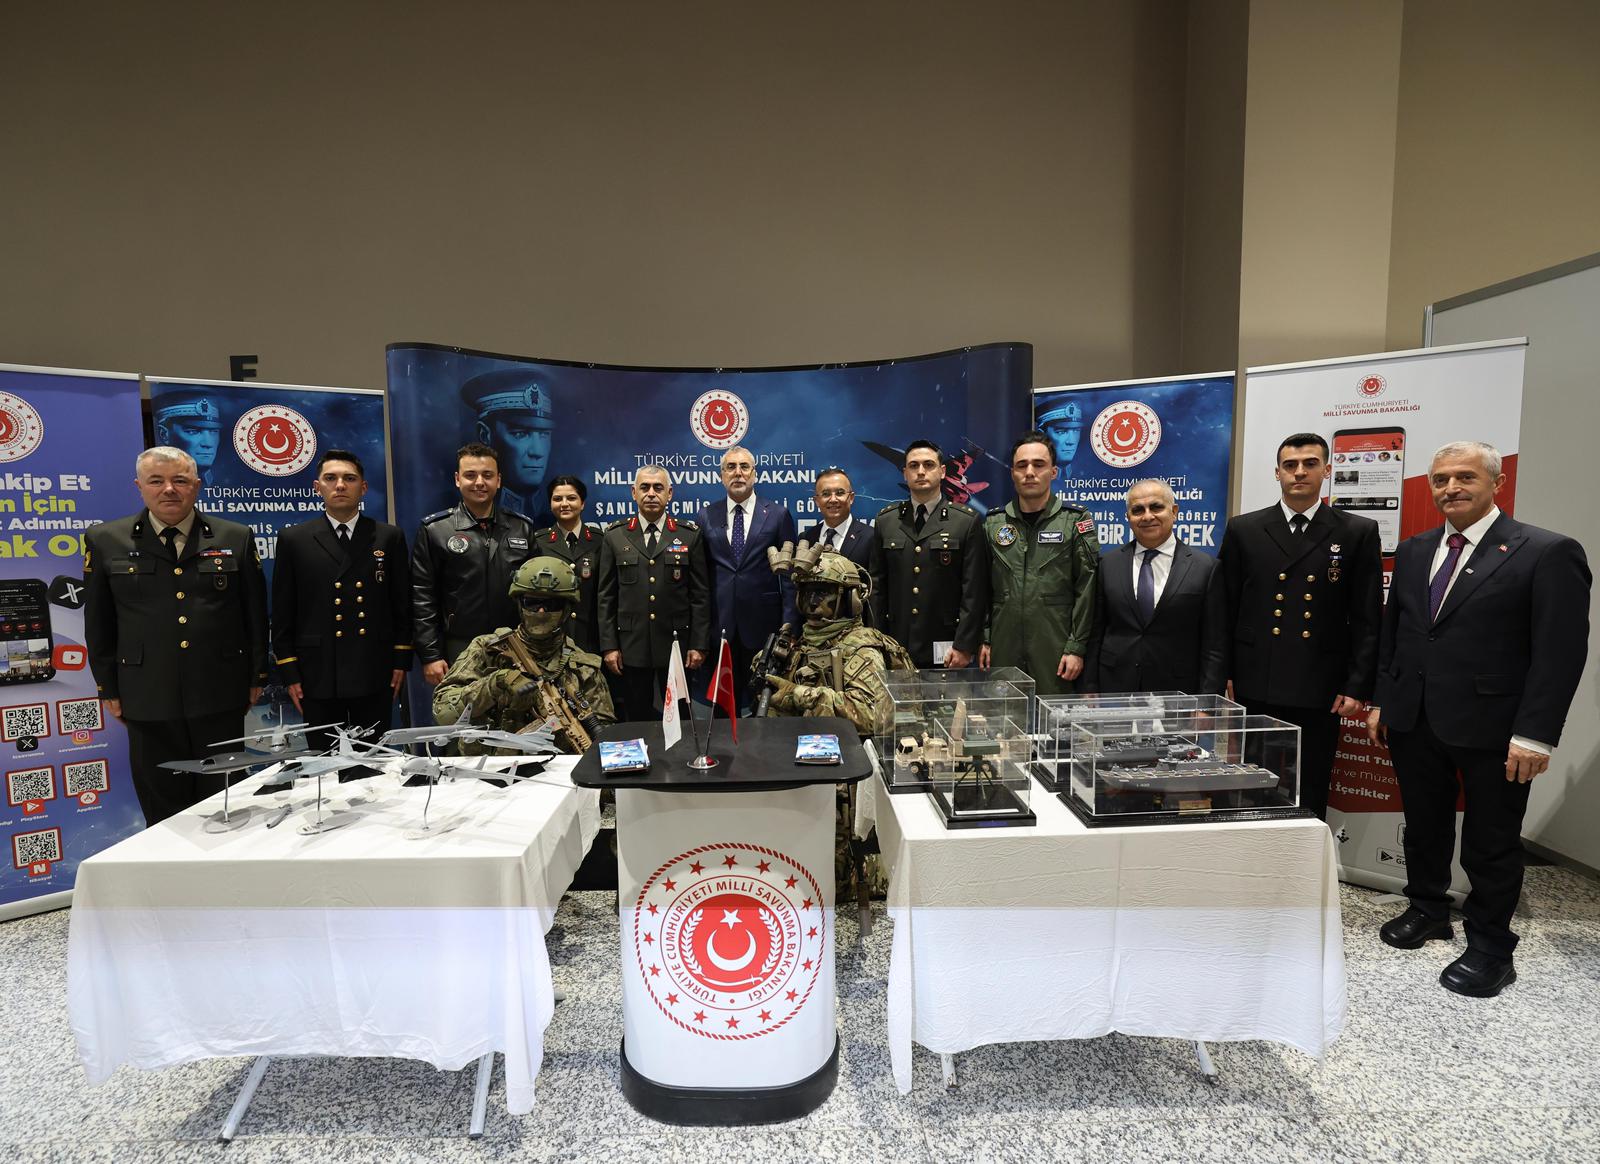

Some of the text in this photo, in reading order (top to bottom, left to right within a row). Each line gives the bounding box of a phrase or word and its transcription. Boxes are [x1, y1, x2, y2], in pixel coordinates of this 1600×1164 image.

[1335, 399, 1409, 410] TÜRKİYE CUMHURİYETİ
[1343, 408, 1378, 416] SAVUNMA
[1380, 404, 1421, 413] BAKANLIĞI
[634, 453, 697, 467] TÜRKİYE
[59, 474, 91, 491] Et
[594, 467, 636, 484] MİLL
[1065, 477, 1107, 488] TÜRKİYE
[204, 486, 323, 498] TÜRKİYE CUMHUR
[1055, 488, 1203, 501] İLLÎ SAVUNM NLIĞI
[24, 492, 76, 515] İçin
[194, 500, 223, 513] İLLÎ
[227, 501, 295, 512] SAVUNMA
[596, 502, 636, 517] ŞANL
[1178, 510, 1217, 521] GÖREV
[1343, 733, 1371, 746] Özel
[1335, 750, 1370, 763] Sanal
[1335, 781, 1391, 800] İçerikler
[755, 887, 797, 939] SAVUNMA
[666, 882, 713, 960] CUMHURİYETİ
[748, 942, 797, 1003] BAKANLIĞI
[671, 962, 717, 1003] TÜRKİYE
